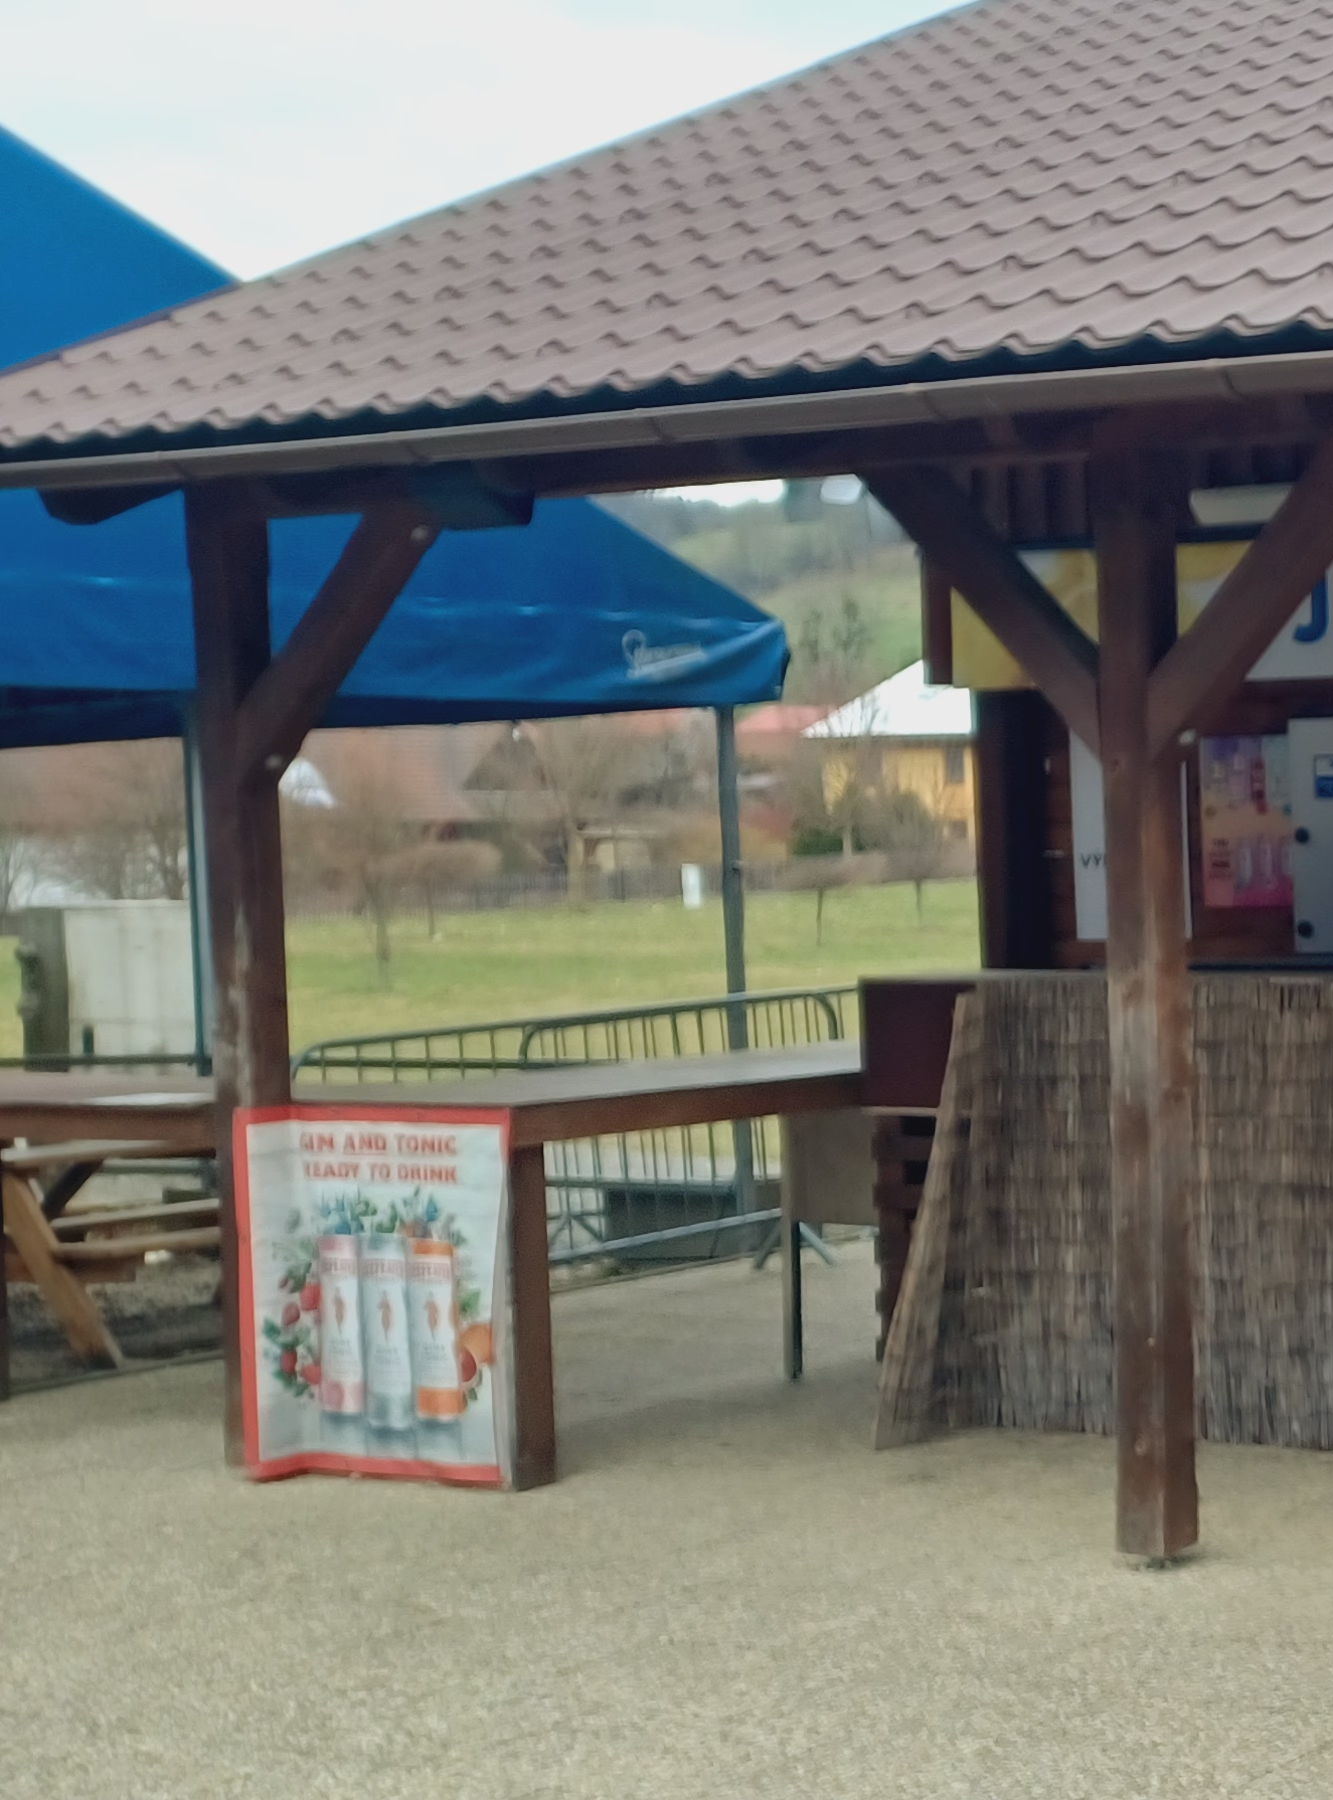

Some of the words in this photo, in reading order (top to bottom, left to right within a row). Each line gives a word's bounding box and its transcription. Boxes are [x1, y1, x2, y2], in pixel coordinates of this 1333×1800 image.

[343, 1132, 388, 1154] AND
[394, 1134, 458, 1155] TONIC
[368, 1162, 391, 1182] TO
[397, 1163, 458, 1183] DRINK
